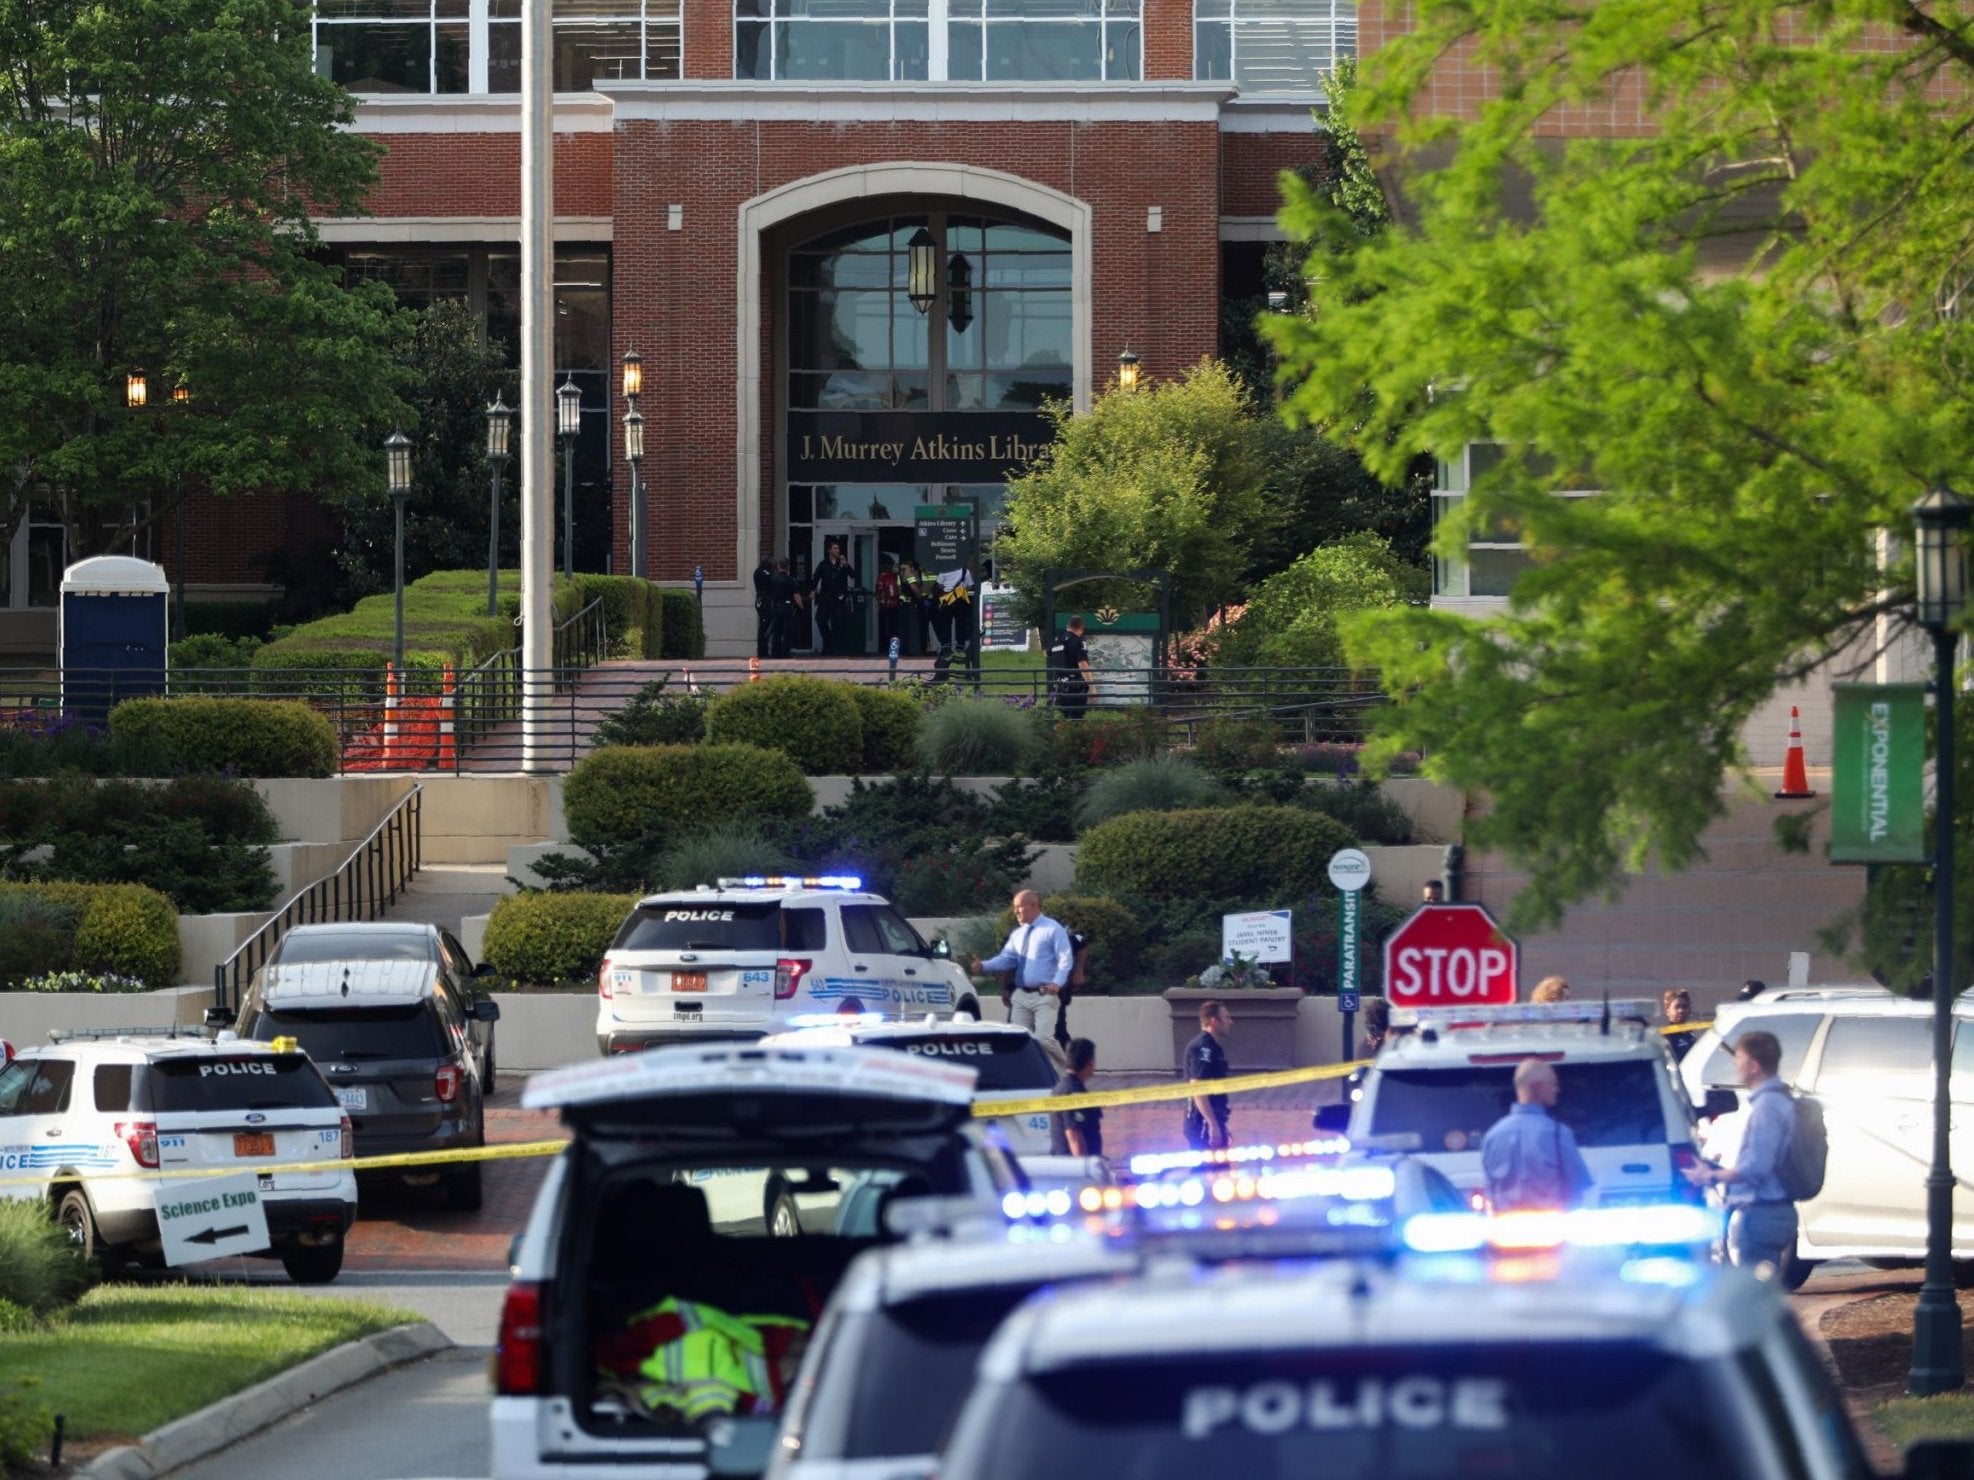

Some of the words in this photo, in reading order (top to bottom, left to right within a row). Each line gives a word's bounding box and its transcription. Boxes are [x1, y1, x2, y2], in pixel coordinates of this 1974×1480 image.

[800, 435, 815, 460] J.
[820, 435, 904, 466] Murrey
[910, 434, 985, 460] Atkins
[990, 434, 1051, 460] Libra
[1870, 703, 1889, 842] EXPONENTIAL
[664, 910, 735, 922] POLICE
[1343, 890, 1356, 989] PARATRANSIT
[743, 972, 769, 982] 643
[1395, 947, 1507, 996] STOP
[882, 988, 935, 1004] POLICE
[906, 1043, 993, 1056] POLICE
[199, 1062, 277, 1077] POLICE
[160, 1139, 185, 1148] 911
[319, 1131, 339, 1143] 187
[161, 1198, 220, 1220] Science
[222, 1191, 256, 1208] Expo
[1182, 1377, 1506, 1439] POLICE
